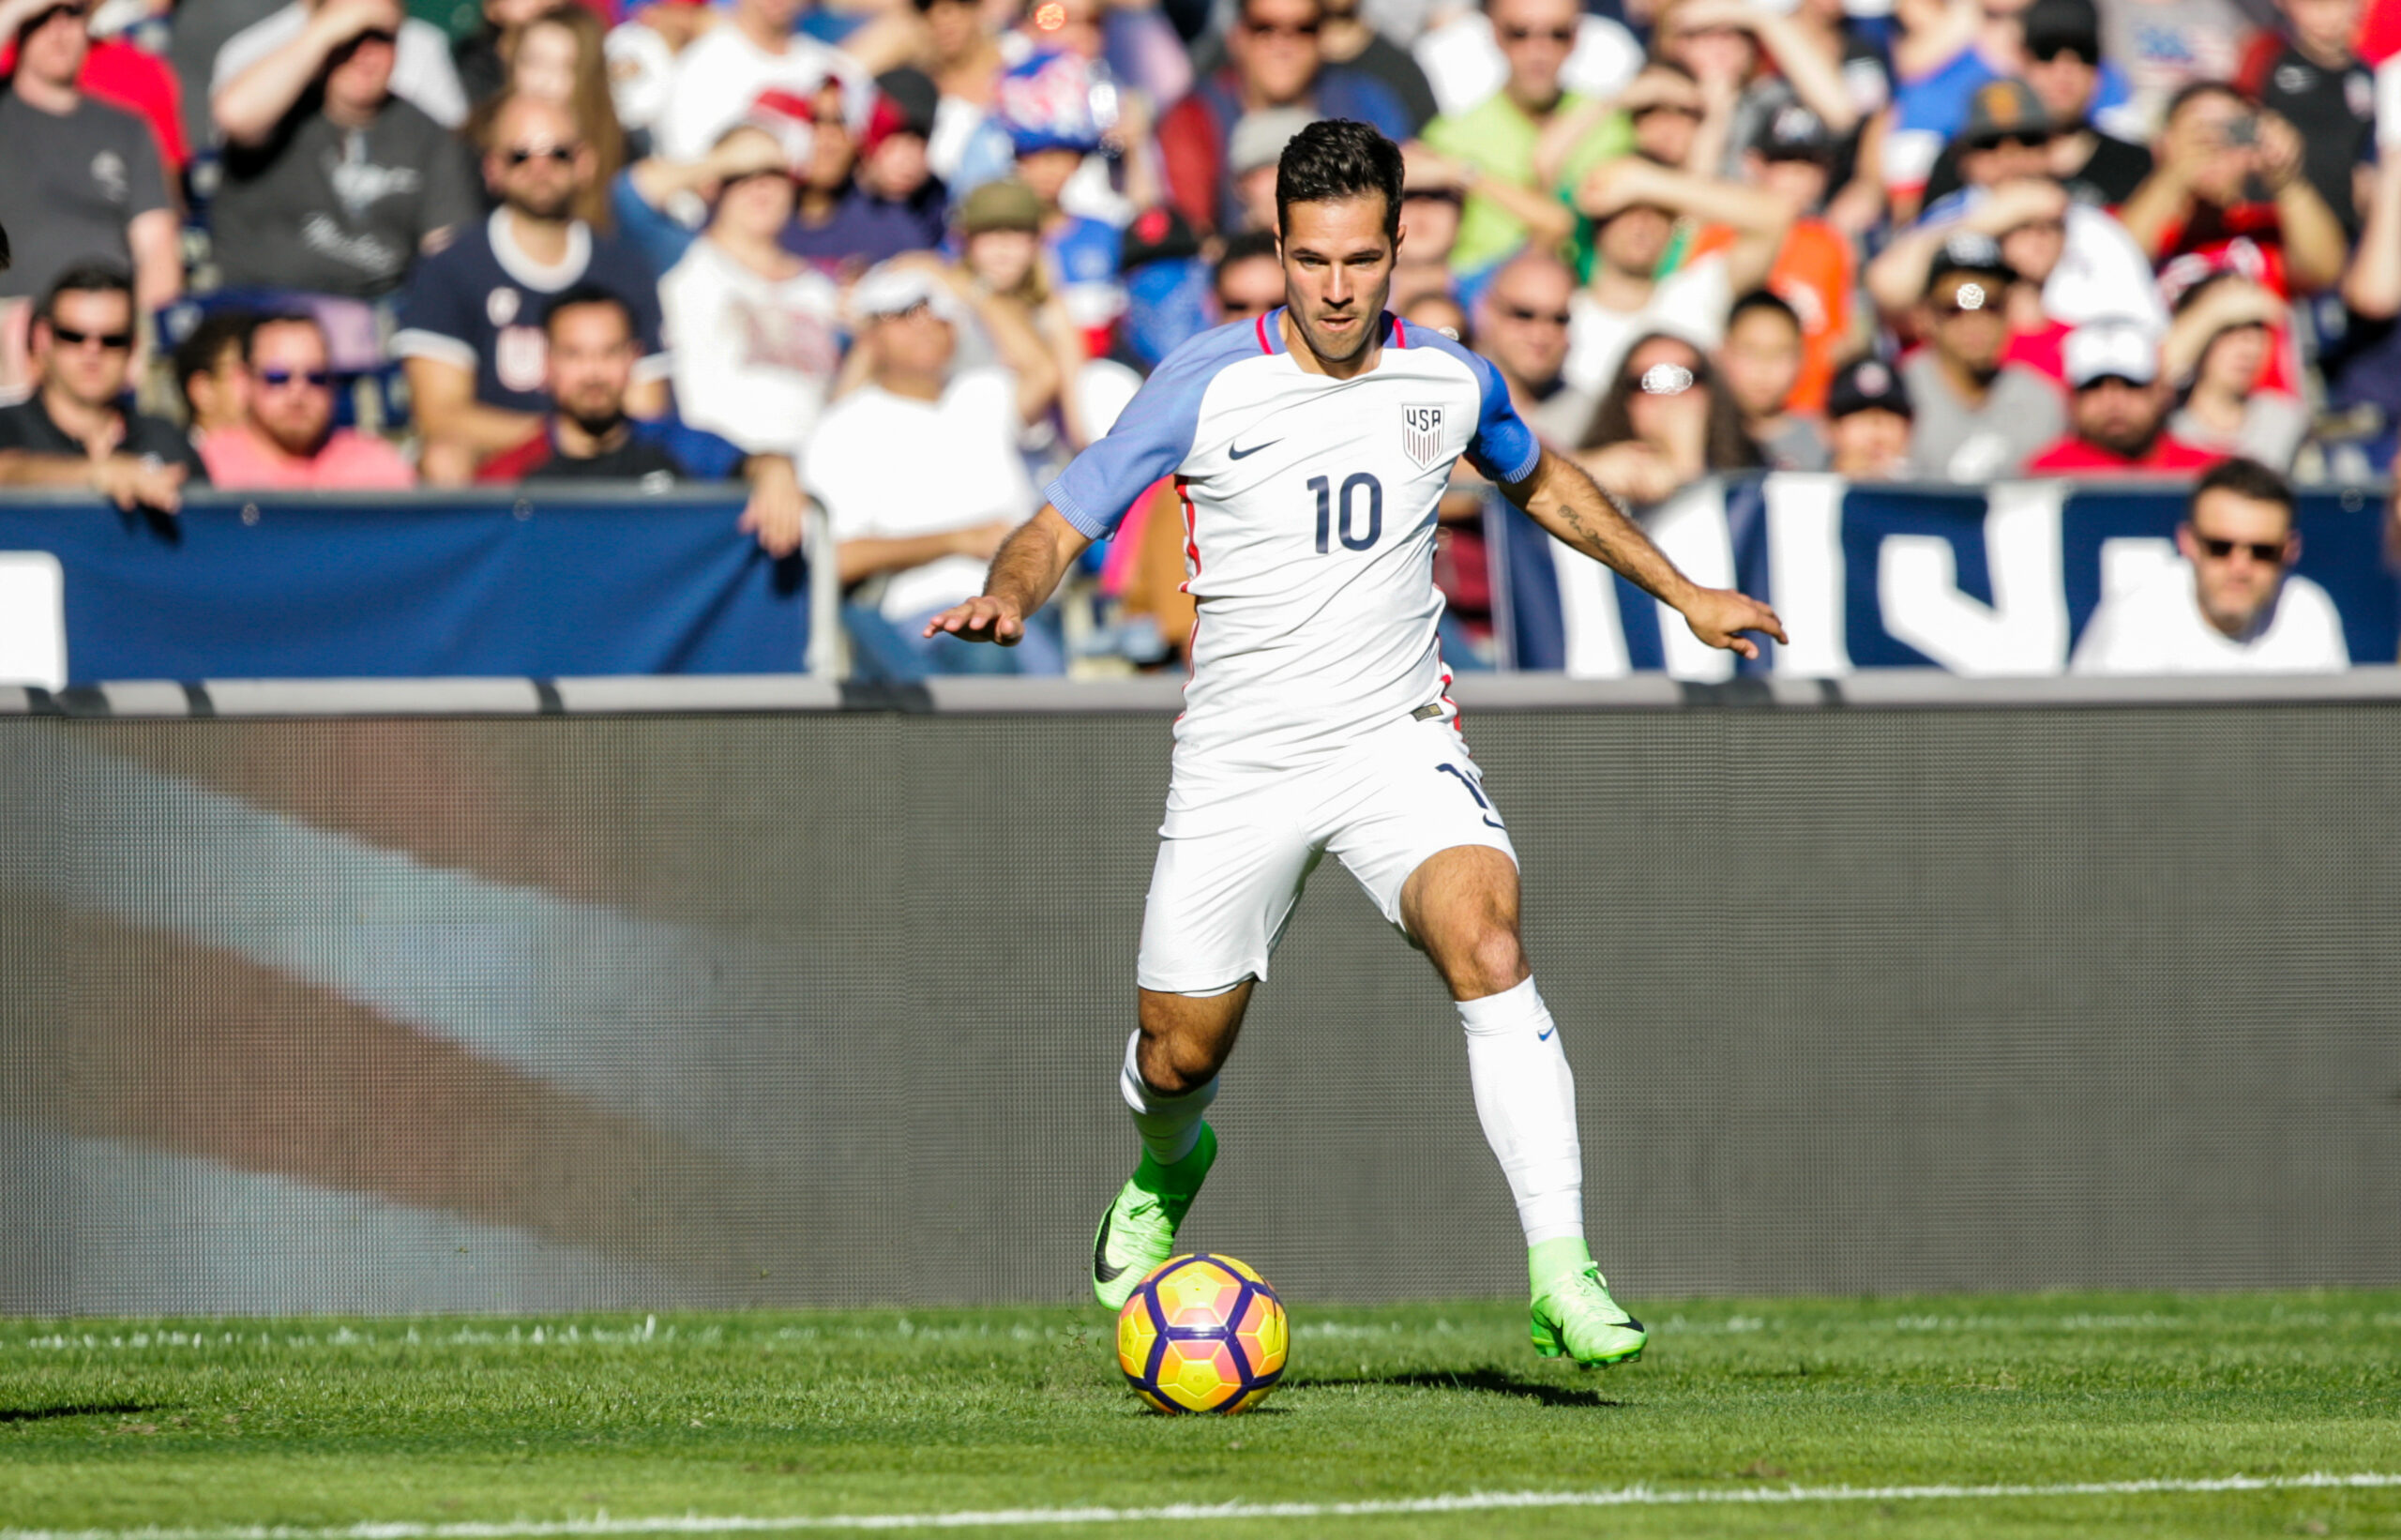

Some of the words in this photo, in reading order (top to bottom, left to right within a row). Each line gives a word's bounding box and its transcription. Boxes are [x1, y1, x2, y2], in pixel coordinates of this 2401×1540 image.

[1406, 409, 1441, 431] USA
[1306, 472, 1382, 554] 10
[1435, 762, 1489, 810] 1
